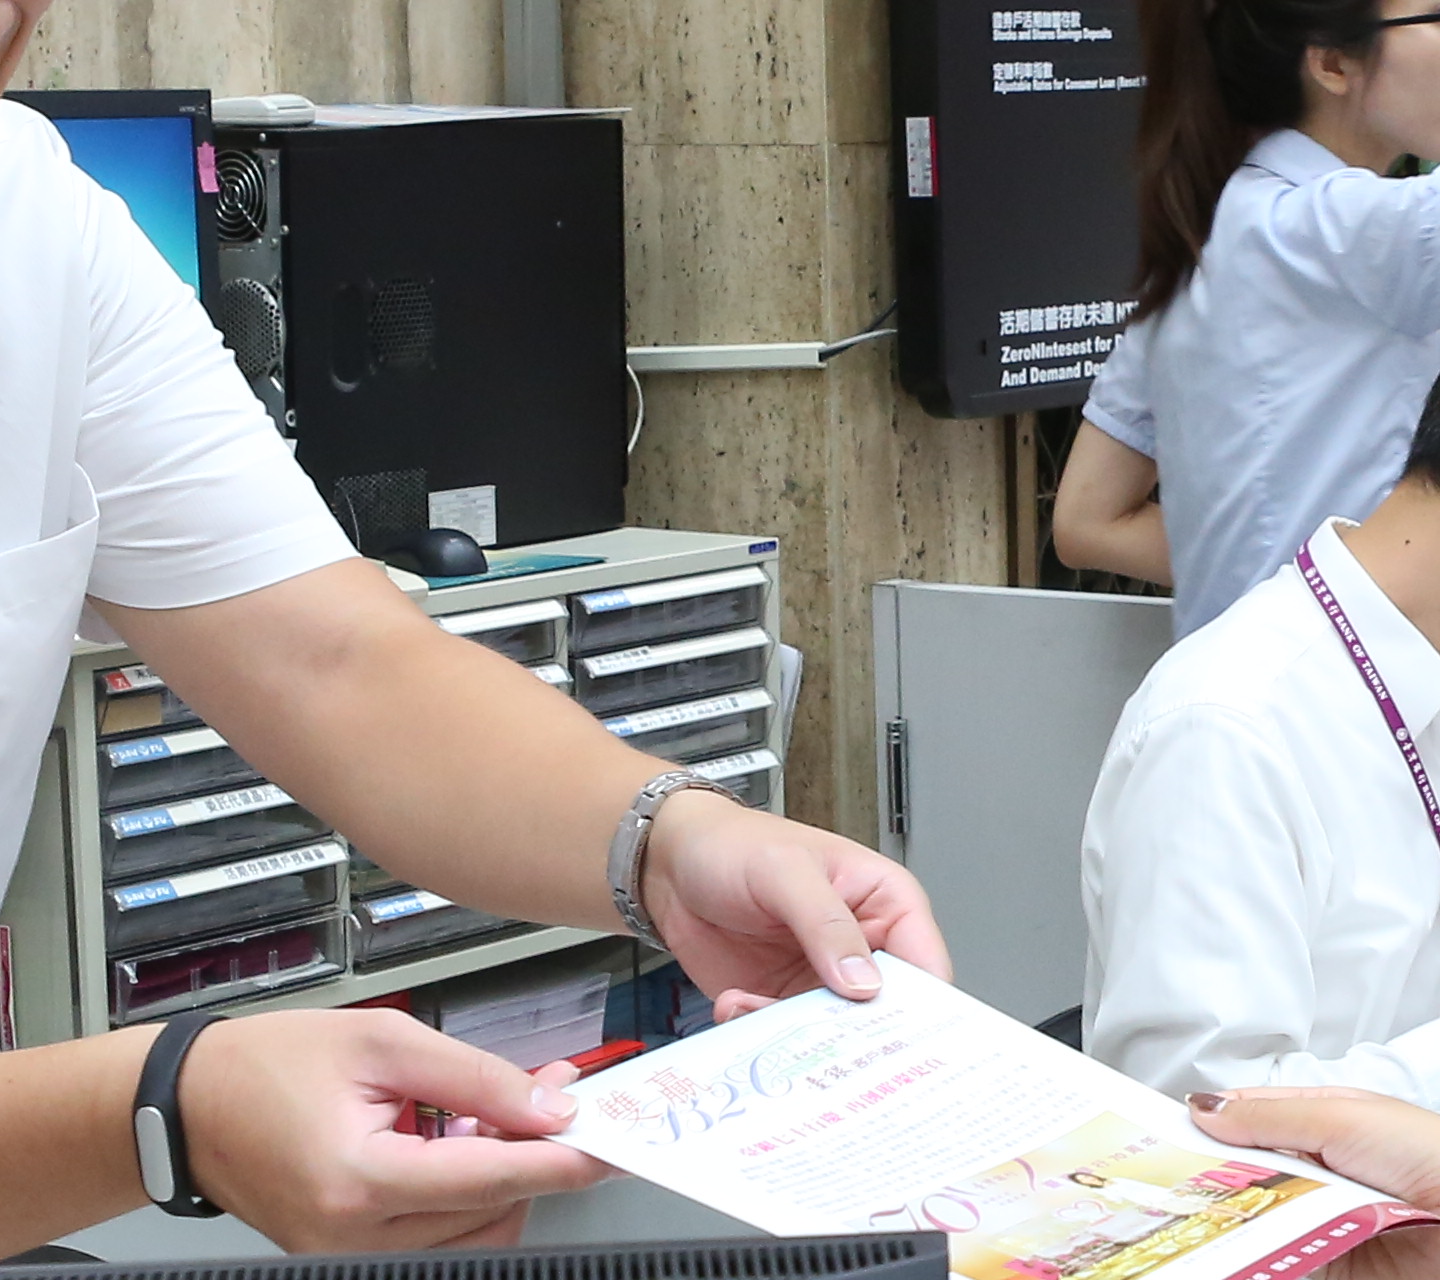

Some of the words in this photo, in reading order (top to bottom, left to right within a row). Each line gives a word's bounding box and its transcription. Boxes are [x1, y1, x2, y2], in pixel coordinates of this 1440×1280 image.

[1094, 335, 1113, 353] for
[1001, 367, 1028, 389] And
[1029, 361, 1081, 385] Demand
[1360, 658, 1389, 701] TAIWAN
[596, 1066, 712, 1122] 雙贏
